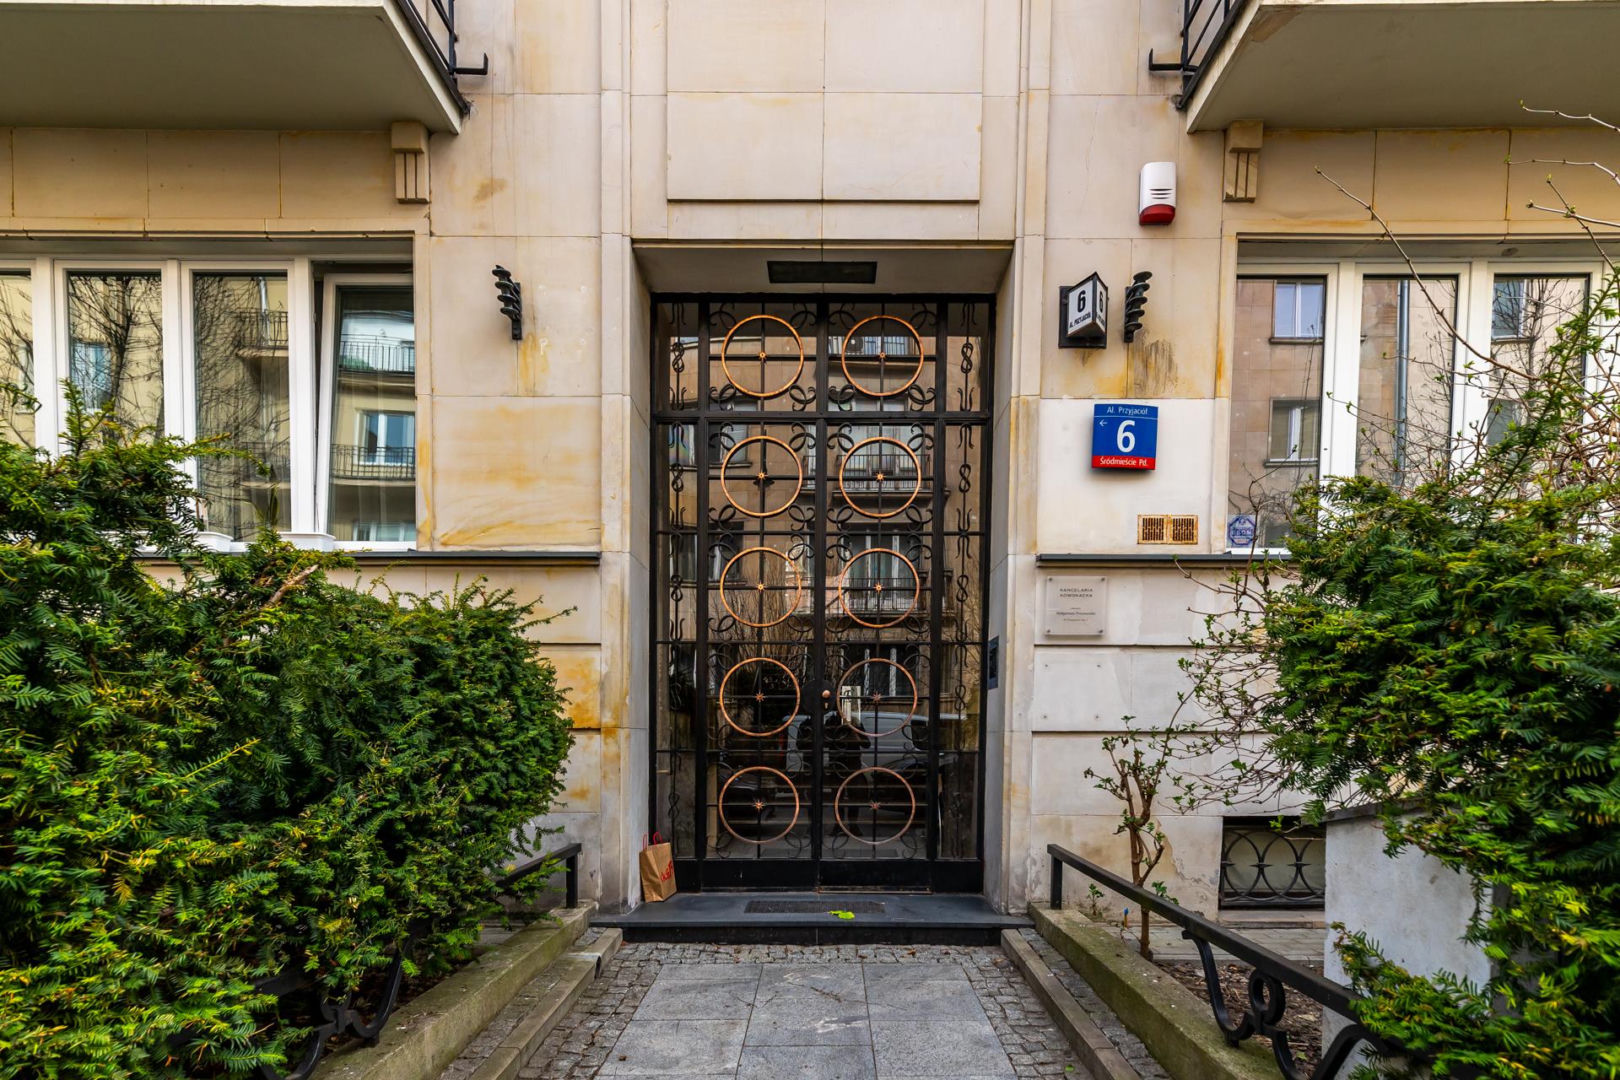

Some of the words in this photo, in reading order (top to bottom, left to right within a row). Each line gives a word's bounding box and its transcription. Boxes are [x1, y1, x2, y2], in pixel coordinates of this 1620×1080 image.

[1077, 289, 1086, 313] 6
[1099, 290, 1104, 314] 6
[1107, 406, 1115, 414] Al.
[1118, 407, 1148, 415] Przyjaciół
[1116, 419, 1136, 453] 6
[1100, 456, 1137, 466] Śródmieście
